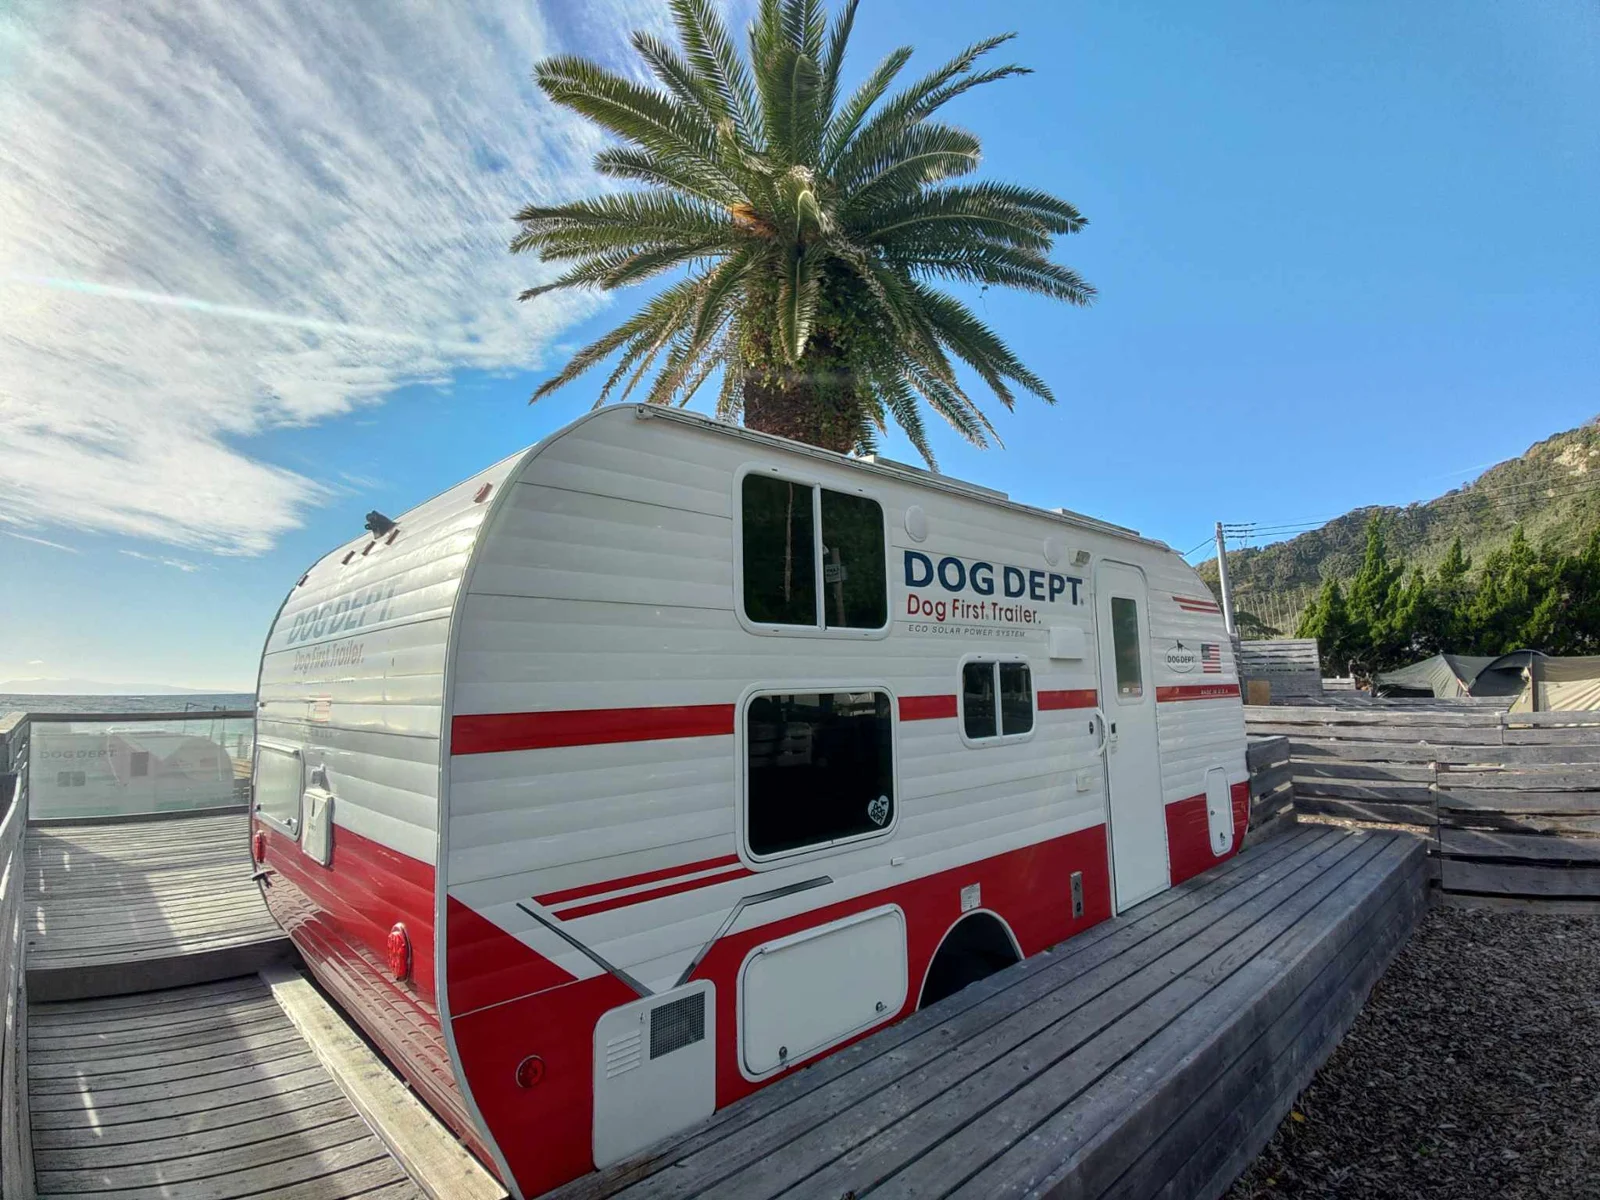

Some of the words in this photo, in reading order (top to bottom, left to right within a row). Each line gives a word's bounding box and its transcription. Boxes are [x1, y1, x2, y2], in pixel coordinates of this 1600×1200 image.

[904, 550, 995, 596] DOG
[1003, 565, 1083, 606] DEPT
[907, 593, 947, 622] Dog
[952, 598, 986, 620] First
[991, 602, 1042, 625] Trailer.
[286, 601, 333, 645] DOG
[908, 624, 929, 633] ECO
[931, 625, 961, 635] SOLAR
[964, 627, 993, 637] POWER
[996, 630, 1026, 638] SYSTEM
[293, 651, 312, 675] Dog
[1167, 655, 1180, 663] DOG
[1180, 655, 1194, 663] DEPT
[40, 750, 74, 759] DOG
[76, 749, 118, 758] DEPT
[874, 803, 886, 816] DOG
